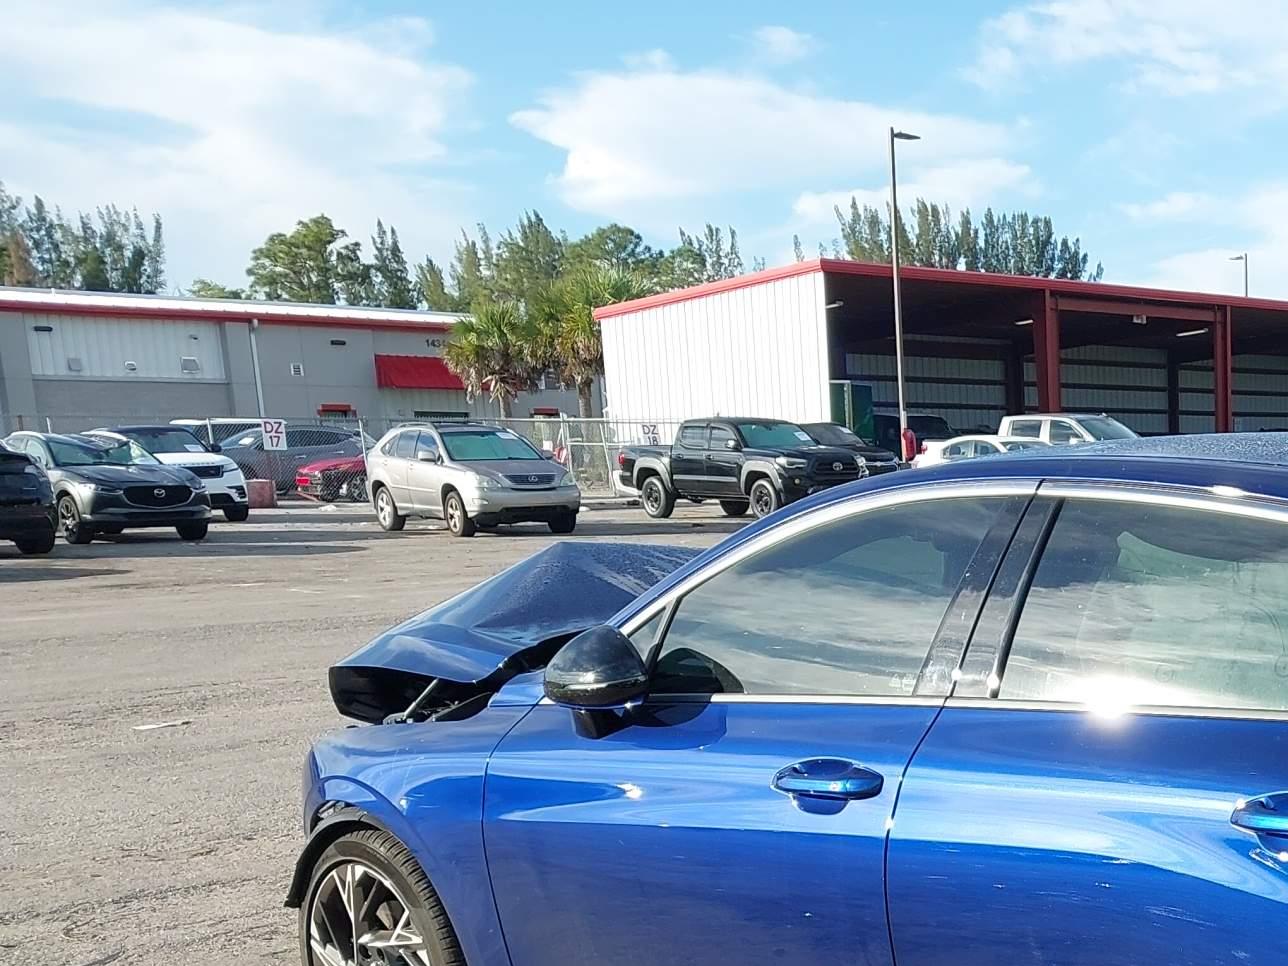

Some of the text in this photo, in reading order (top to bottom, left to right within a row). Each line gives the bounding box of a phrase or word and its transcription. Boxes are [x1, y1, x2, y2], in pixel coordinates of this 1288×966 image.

[264, 421, 283, 434] DZ
[642, 424, 659, 435] DZ
[269, 435, 281, 448] 17
[647, 435, 659, 446] 18
